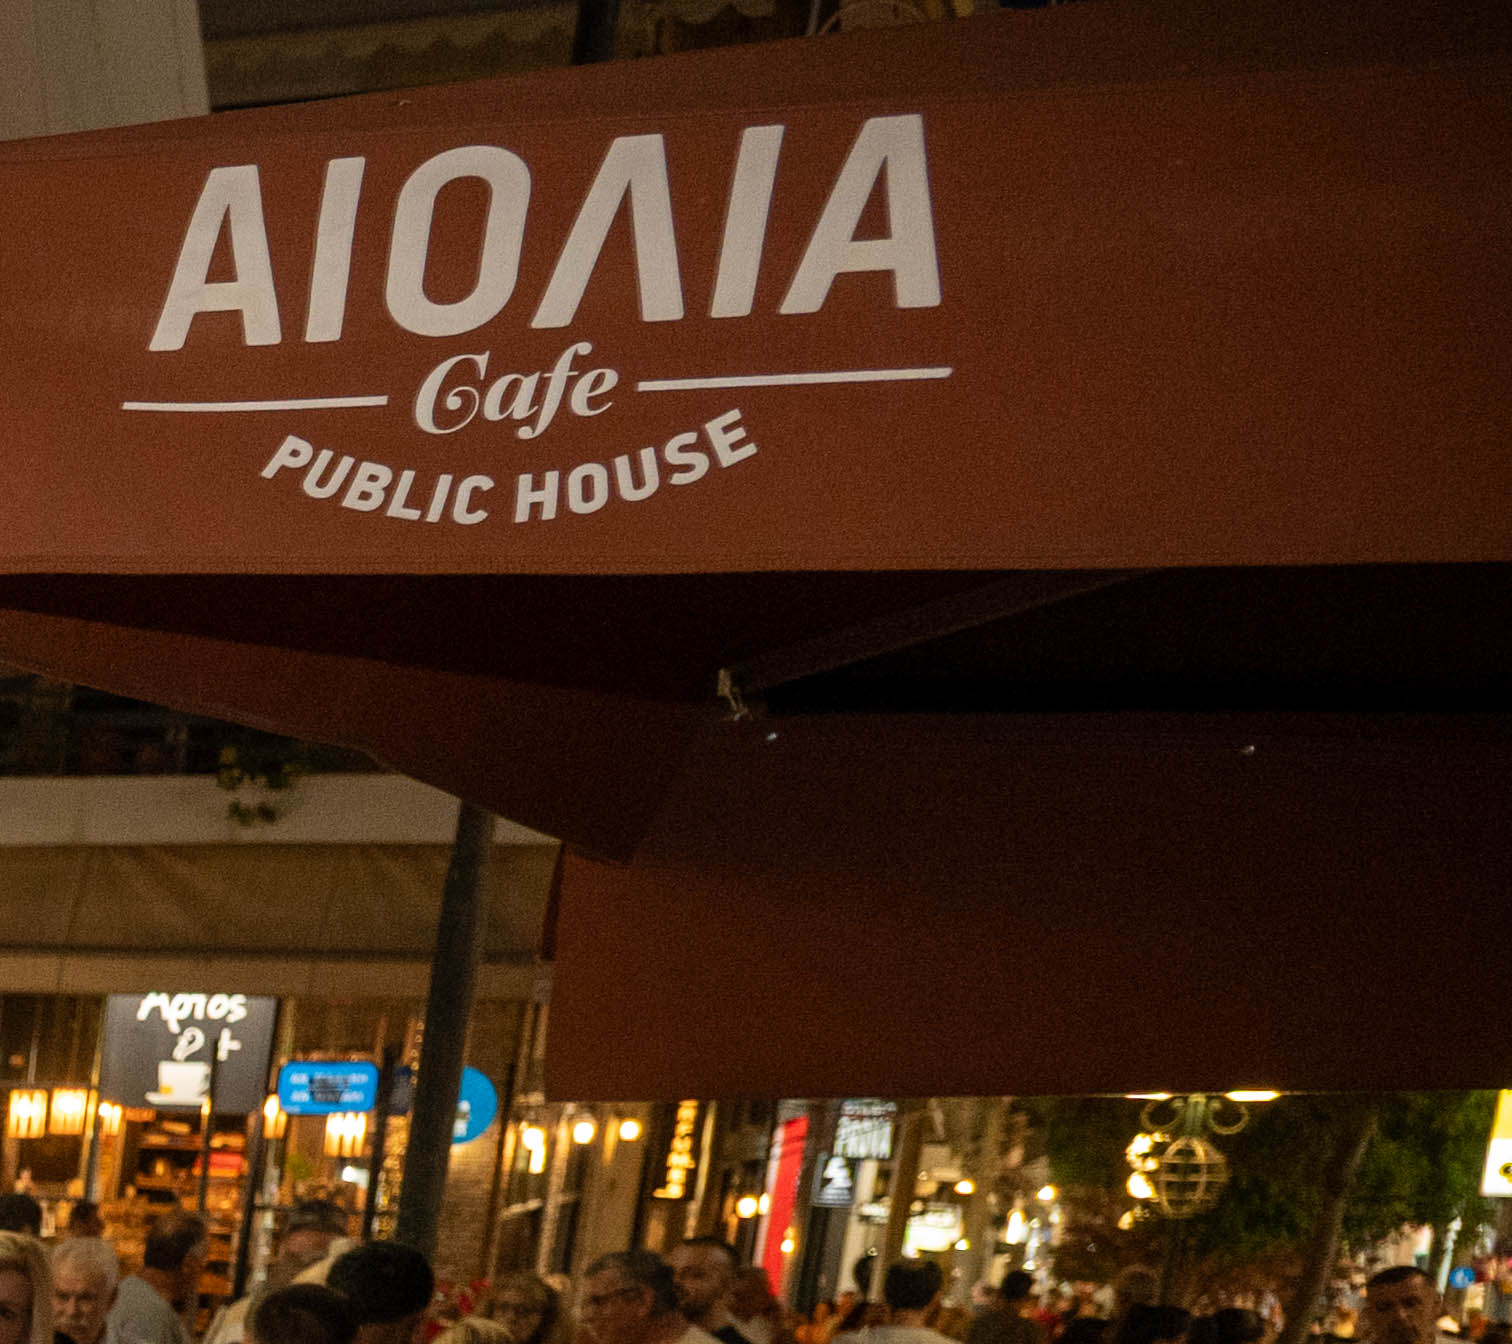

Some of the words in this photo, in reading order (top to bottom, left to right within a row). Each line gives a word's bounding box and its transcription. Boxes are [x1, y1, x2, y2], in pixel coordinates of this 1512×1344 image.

[148, 113, 942, 353] ΑΙΟΛΙΑ
[414, 341, 619, 440] Cafe
[260, 434, 495, 526] PUBLIC
[513, 407, 758, 525] HOUSE
